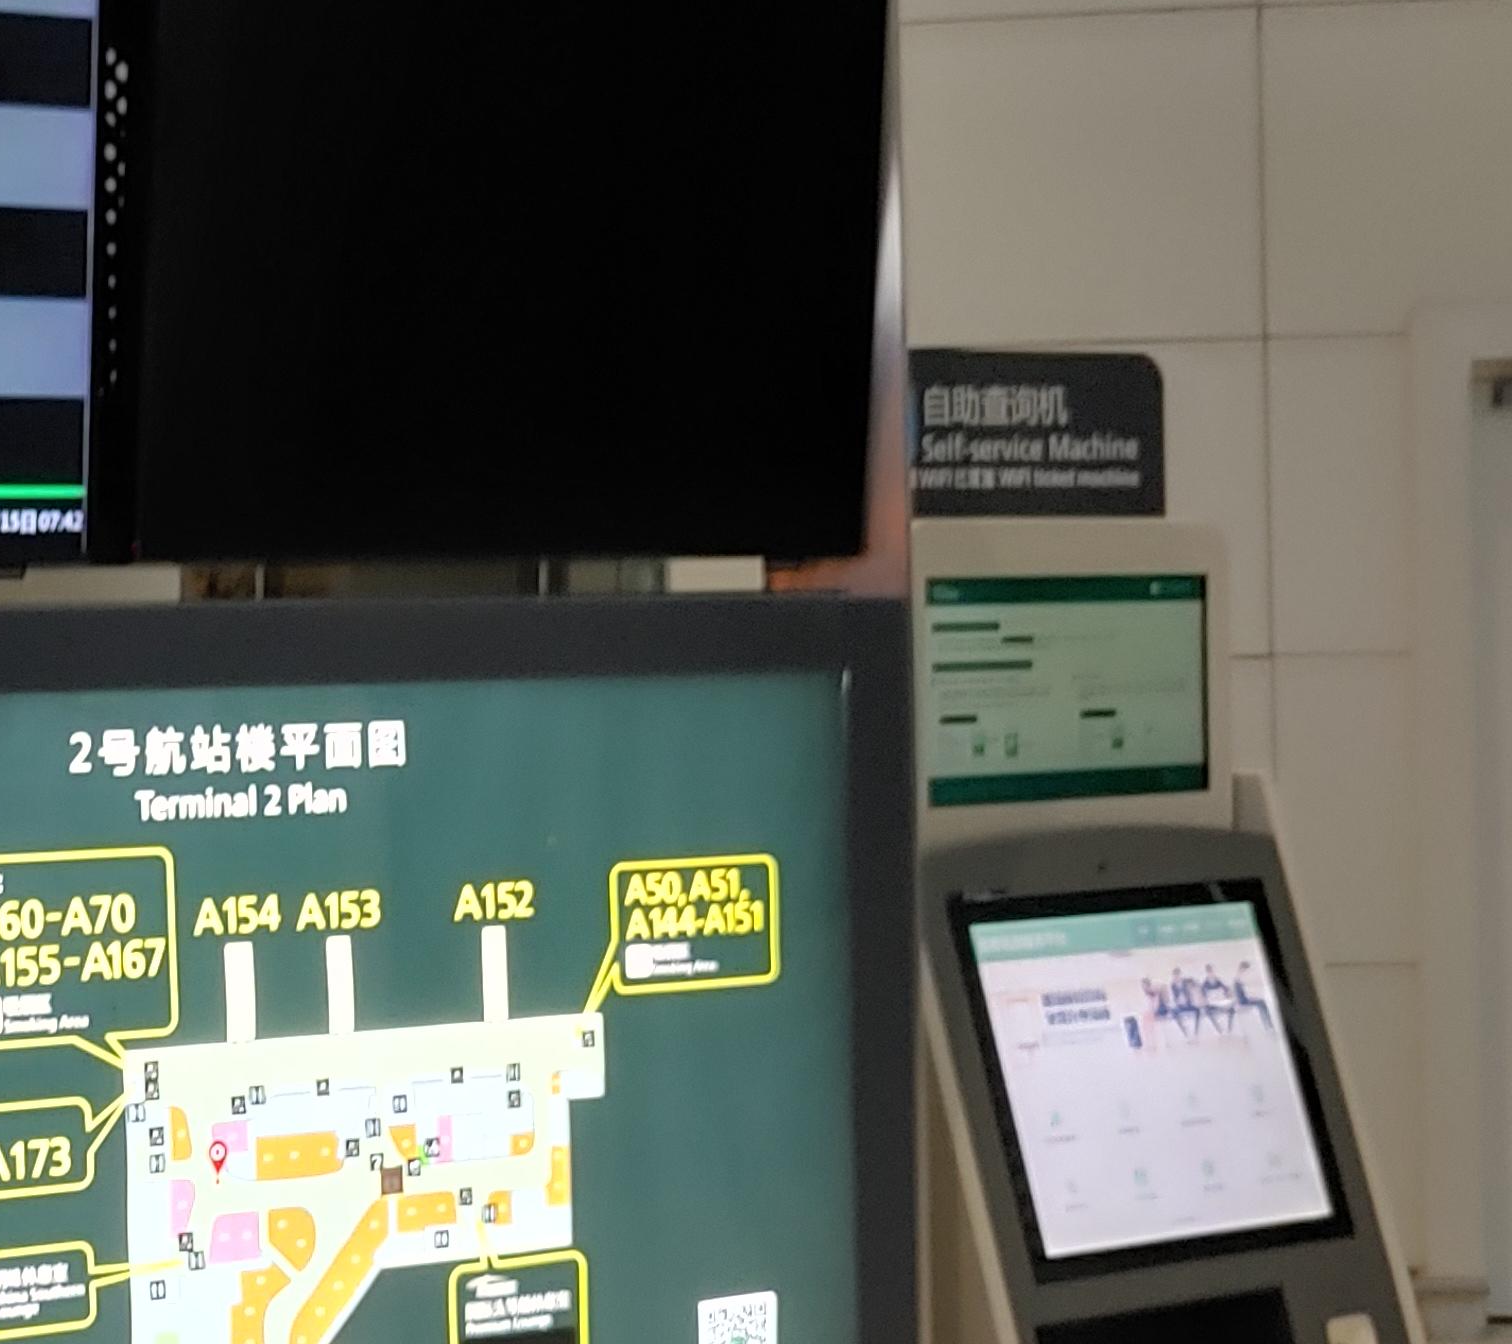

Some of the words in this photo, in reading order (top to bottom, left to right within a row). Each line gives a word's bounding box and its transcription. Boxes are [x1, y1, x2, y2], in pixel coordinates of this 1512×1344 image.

[924, 384, 1069, 427] 自助查询机
[921, 431, 1044, 463] Self-service
[1049, 431, 1139, 461] Machine
[68, 719, 407, 776] 2号航站楼平面图
[134, 784, 258, 821] Terminal
[262, 785, 283, 816] 2
[287, 782, 348, 815] Plan
[193, 891, 281, 937] A154
[296, 889, 381, 934] A153
[453, 879, 535, 923] A152
[625, 899, 765, 942] A144-A151
